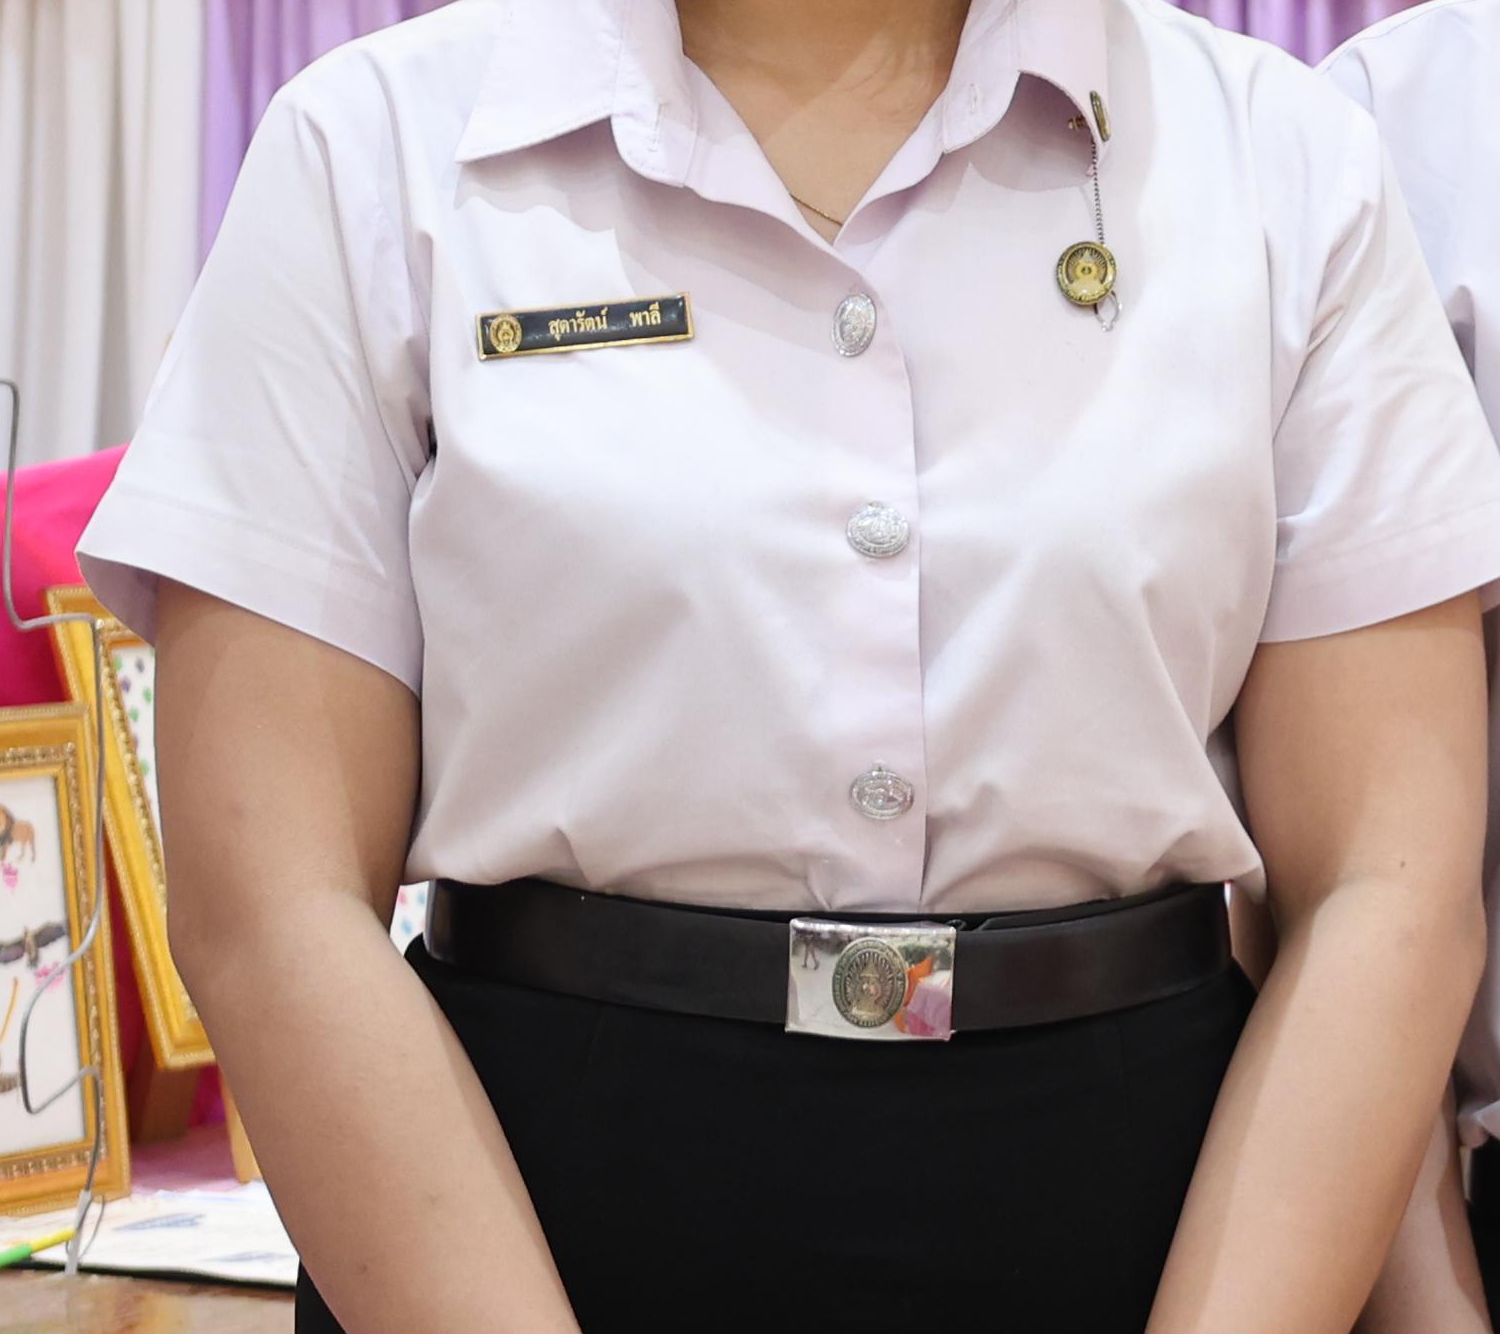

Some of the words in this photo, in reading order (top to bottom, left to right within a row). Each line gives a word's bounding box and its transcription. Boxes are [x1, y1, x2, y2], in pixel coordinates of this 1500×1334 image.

[548, 307, 608, 341] สุดารัตน์
[629, 301, 662, 327] พาลี
